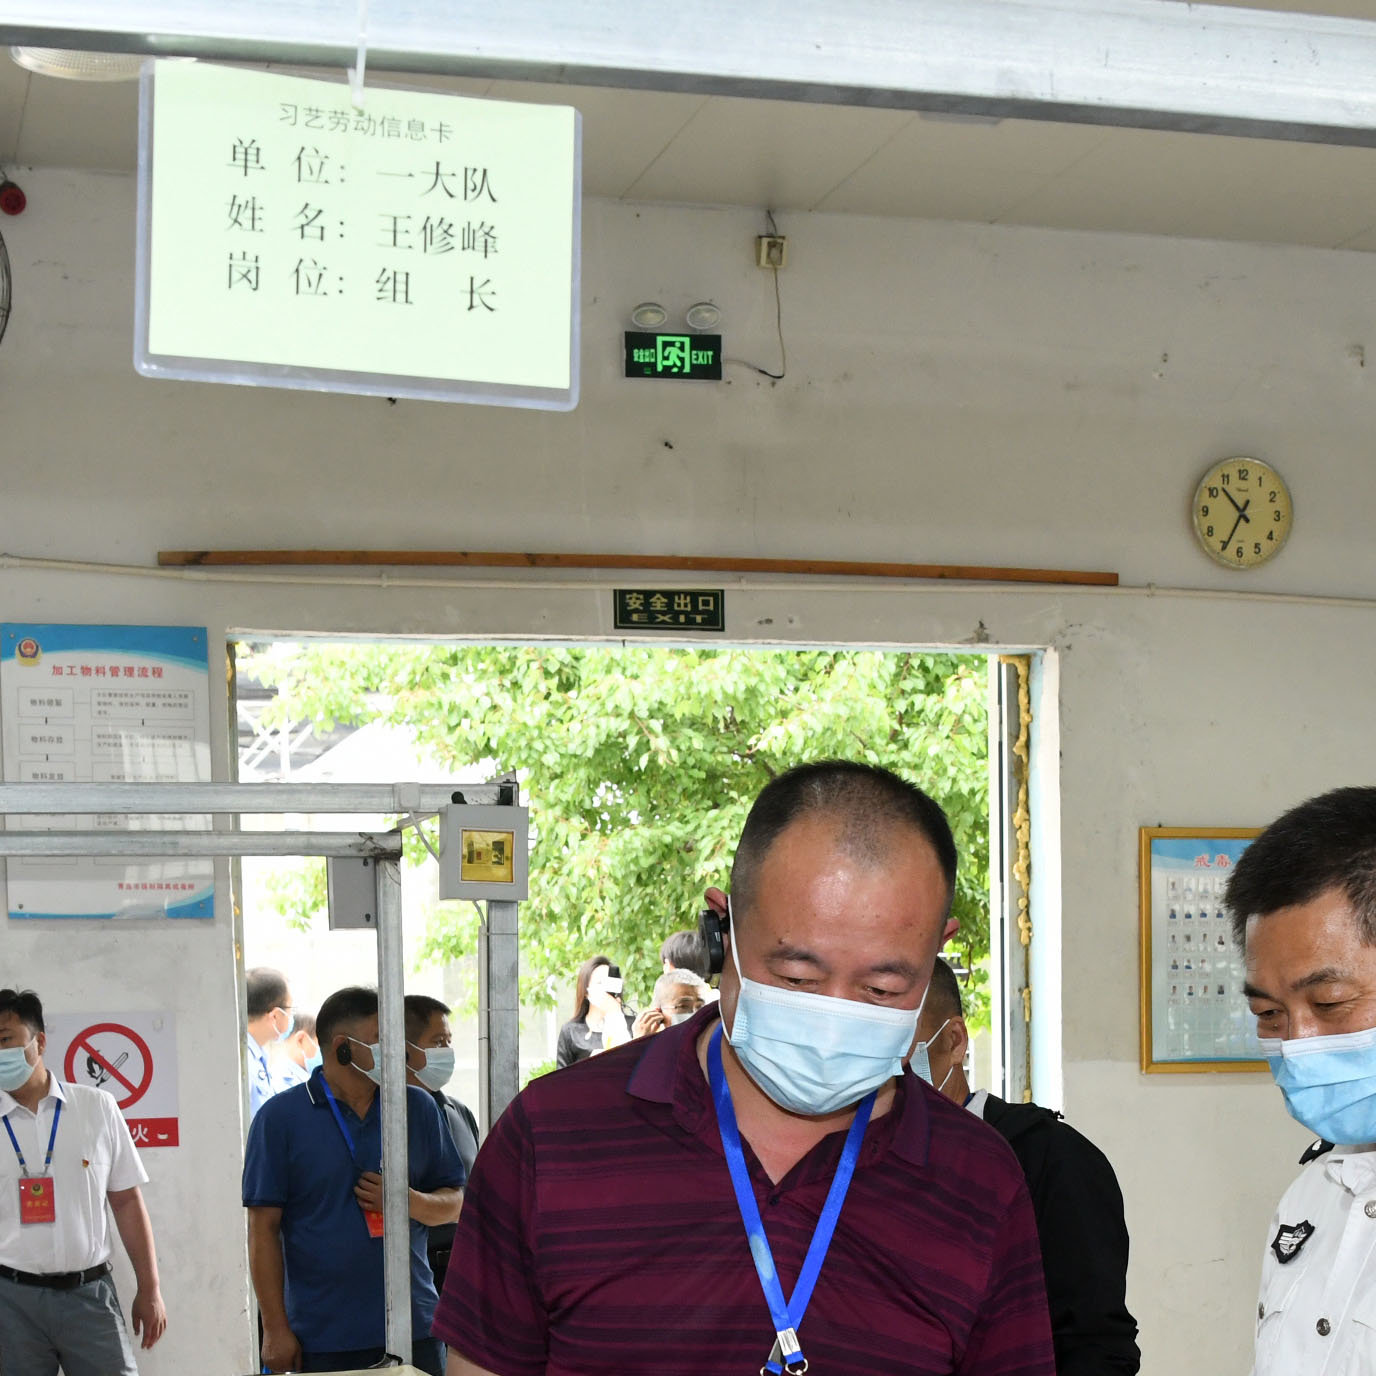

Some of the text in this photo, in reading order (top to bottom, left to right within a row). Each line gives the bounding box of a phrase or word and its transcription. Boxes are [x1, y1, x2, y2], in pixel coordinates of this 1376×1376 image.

[278, 102, 454, 143] 习艺劳动信息卡
[691, 350, 713, 365] EXIT
[1221, 474, 1230, 485] 11
[1238, 469, 1249, 481] 12
[1258, 476, 1263, 488] 1
[1208, 487, 1219, 498] 10
[1269, 491, 1277, 503] 2
[1201, 505, 1209, 517] 9
[1273, 510, 1281, 522] 3
[1206, 525, 1214, 537] 8
[1267, 530, 1274, 541] 4
[1236, 547, 1244, 558] 6
[1254, 543, 1262, 554] 5
[625, 593, 714, 612] 安全出口
[631, 613, 708, 624] EXIT
[51, 664, 164, 679] 加工物料管理流程
[1192, 854, 1234, 869] 戒毒
